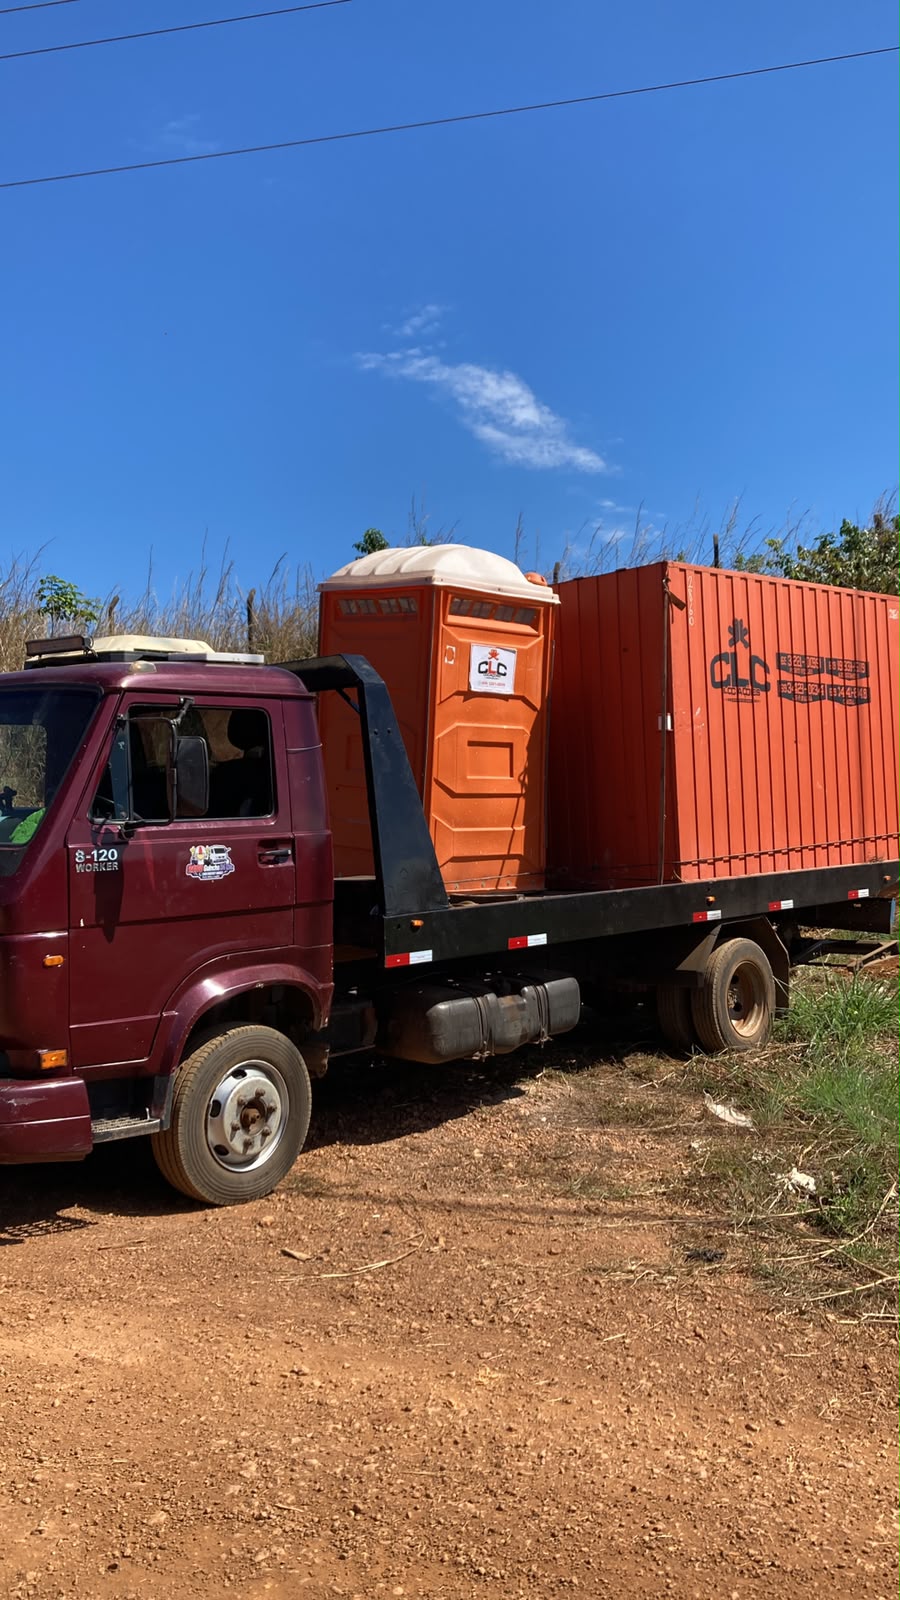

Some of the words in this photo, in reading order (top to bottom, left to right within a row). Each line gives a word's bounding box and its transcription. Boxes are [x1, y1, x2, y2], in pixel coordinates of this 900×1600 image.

[478, 660, 508, 677] CLC
[710, 652, 771, 692] CLC
[75, 848, 118, 863] 8-120
[75, 862, 119, 873] WORKER
